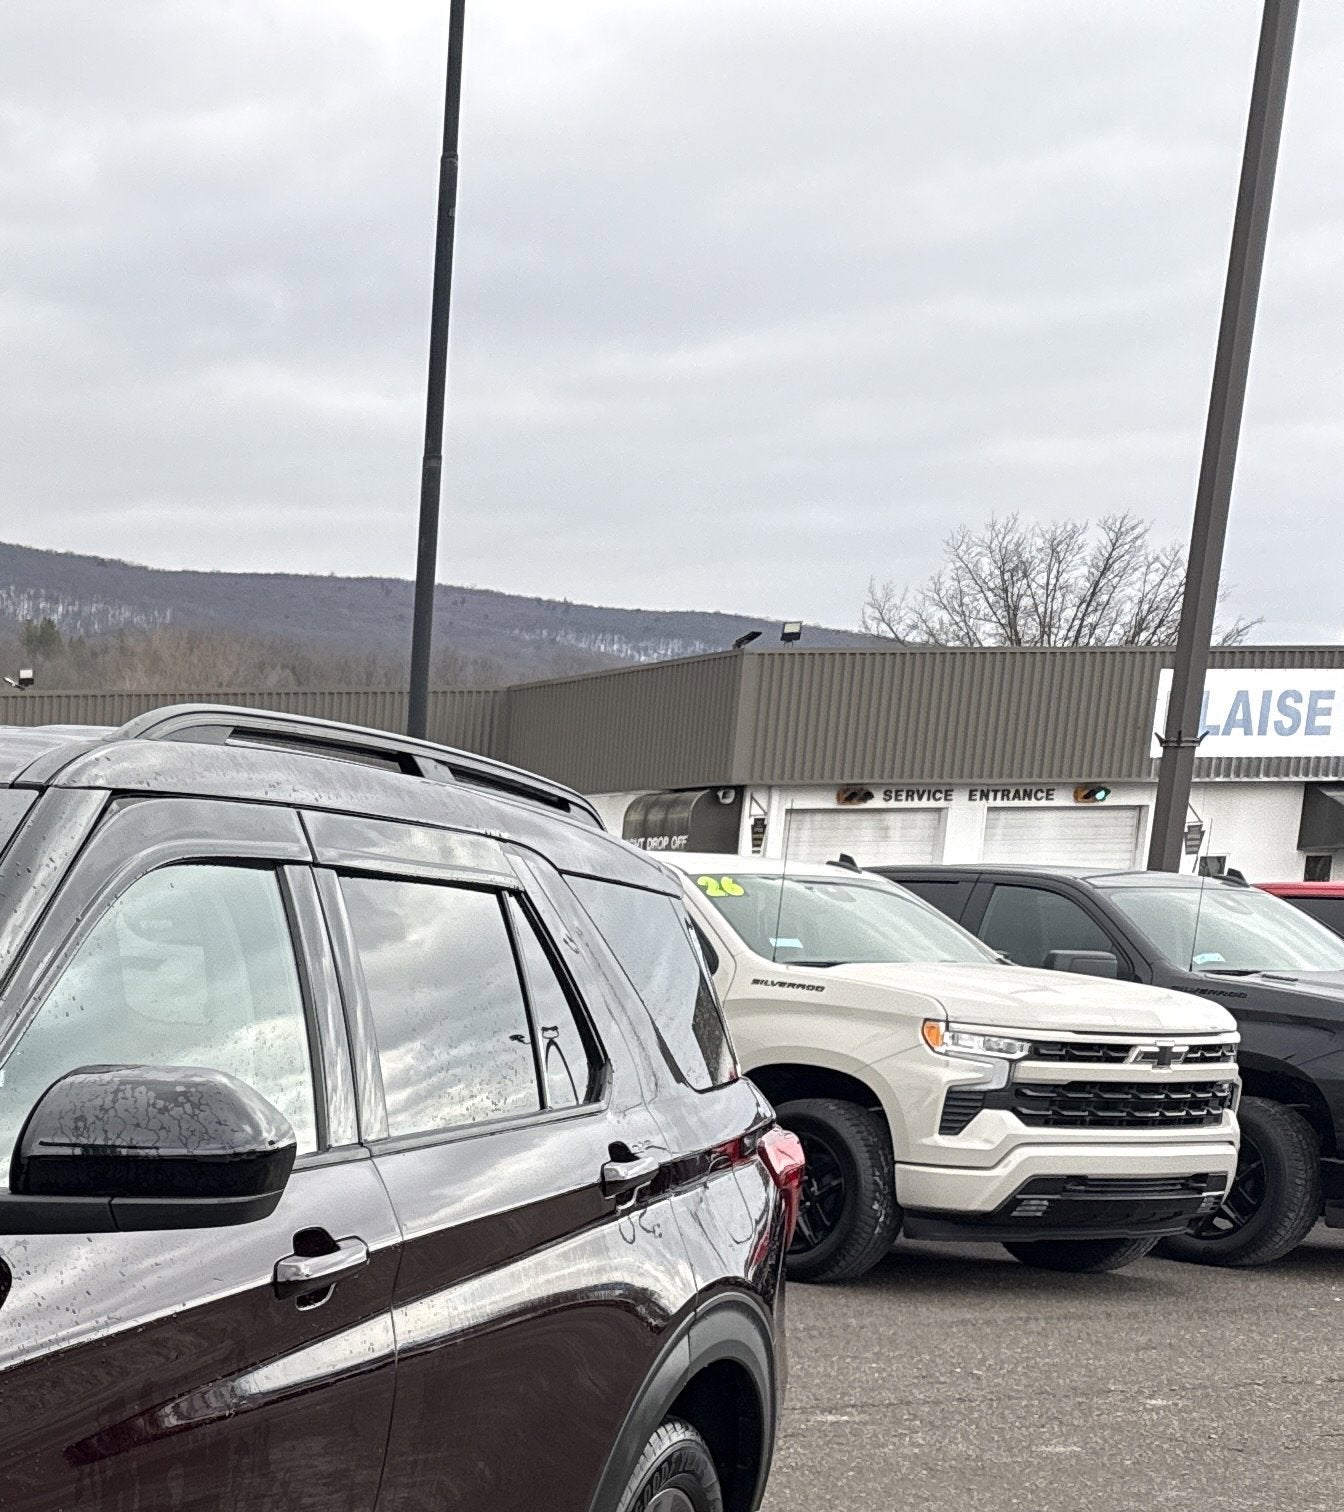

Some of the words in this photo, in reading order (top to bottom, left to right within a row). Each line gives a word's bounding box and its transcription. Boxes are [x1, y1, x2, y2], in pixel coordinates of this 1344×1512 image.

[1165, 689, 1336, 737] LAISE
[882, 788, 954, 802] SERVICE
[968, 787, 1056, 802] ENTRANCE
[646, 835, 669, 850] DROP
[671, 834, 689, 849] OFF
[751, 978, 825, 992] SILVERADO
